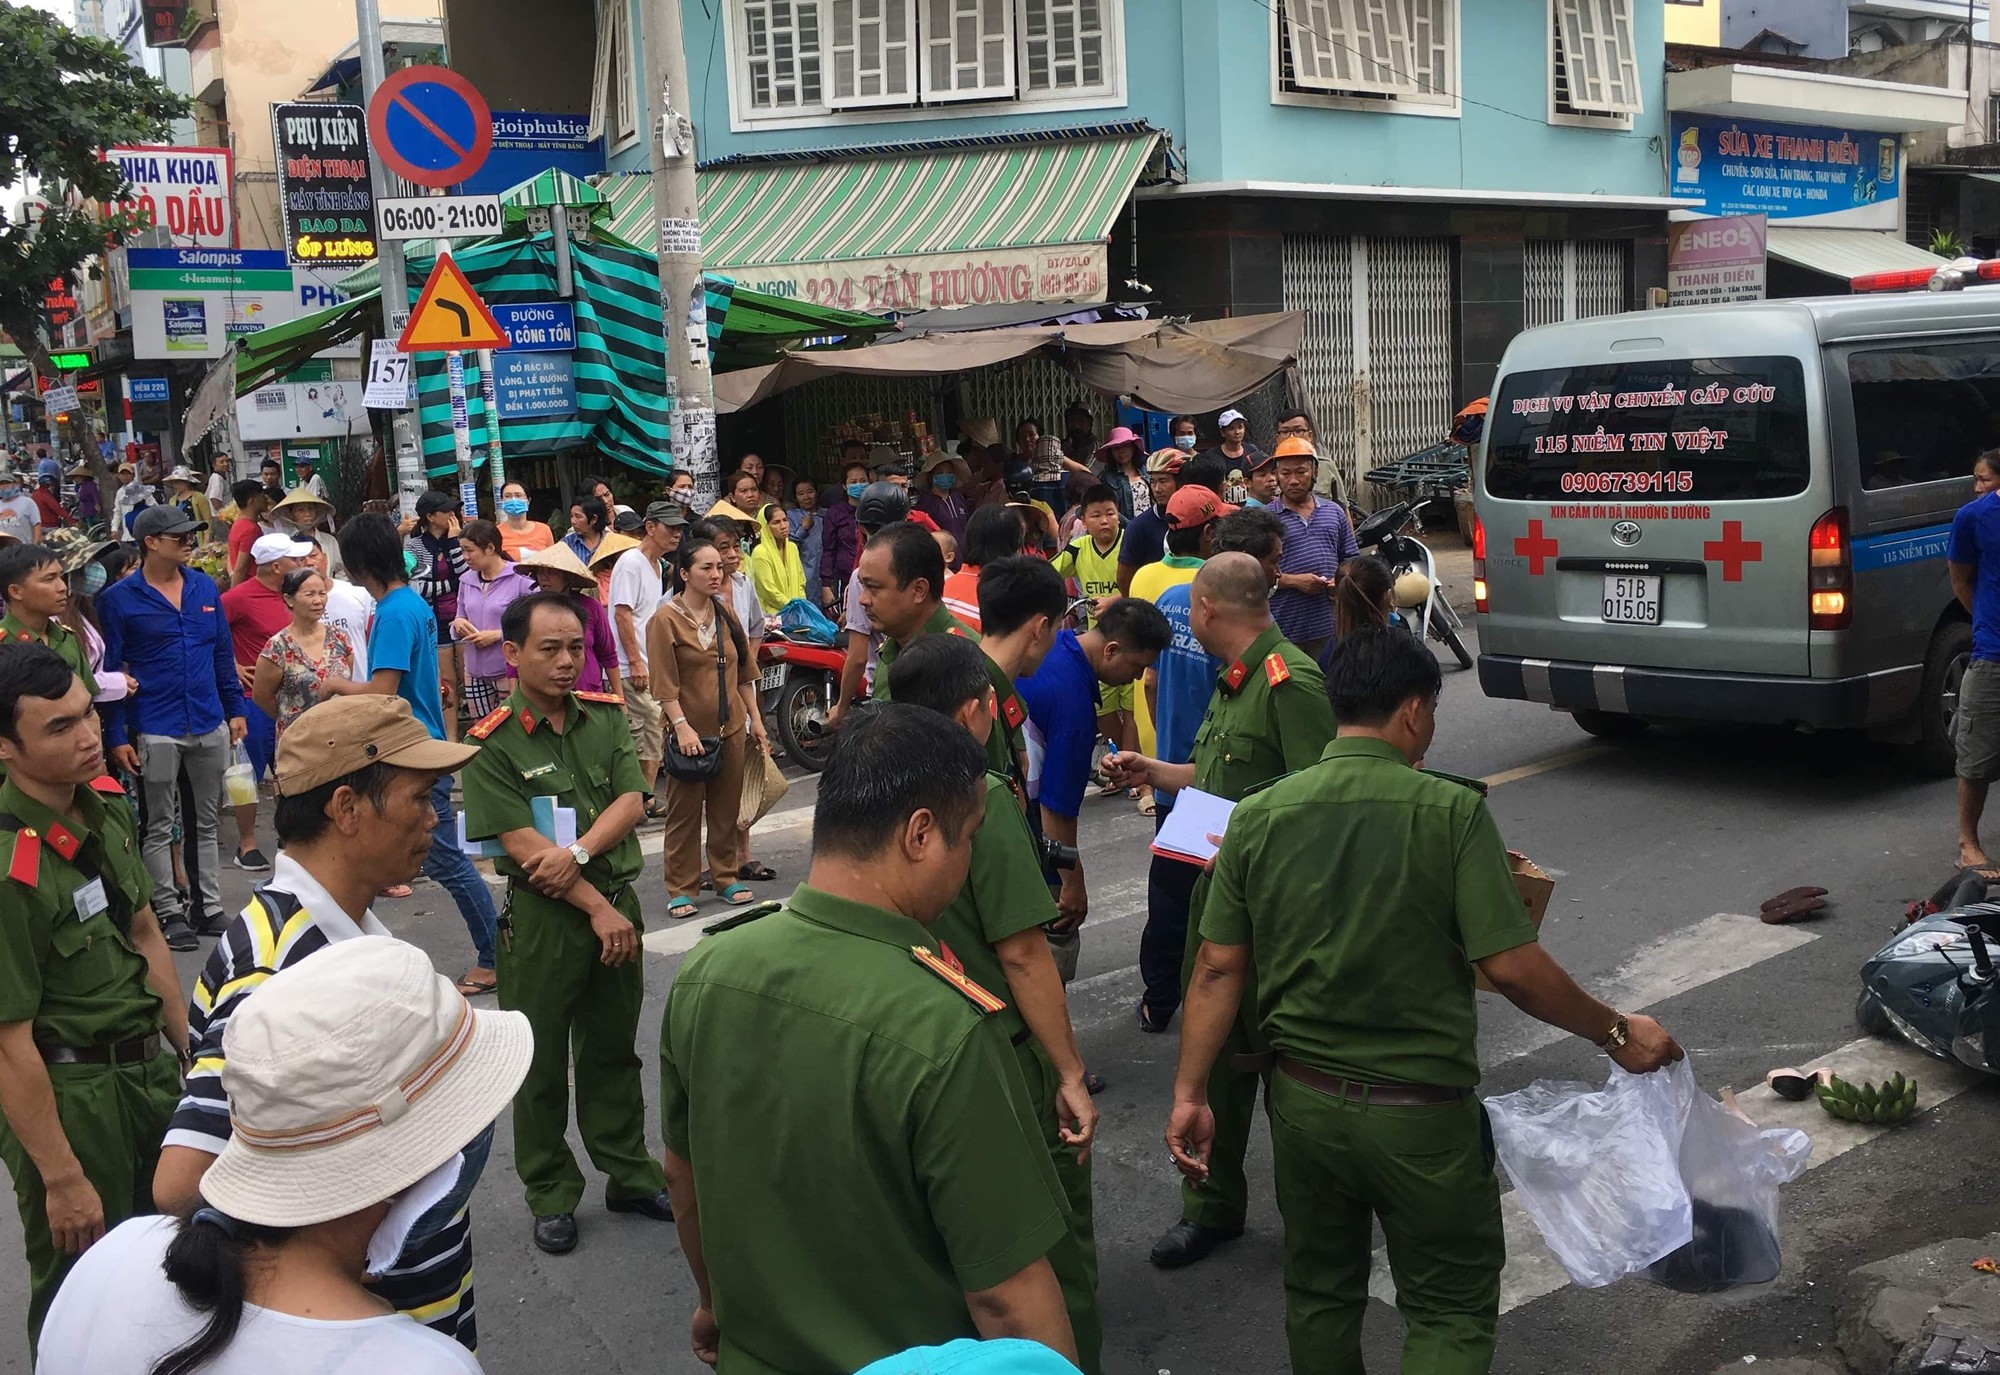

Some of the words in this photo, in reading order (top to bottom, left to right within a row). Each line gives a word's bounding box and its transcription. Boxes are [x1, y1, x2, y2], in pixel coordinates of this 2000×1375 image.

[285, 117, 318, 150] PHỤ
[320, 110, 358, 152] KIỆN
[1719, 124, 1750, 156] SỬA
[1752, 134, 1773, 158] XE
[1776, 136, 1824, 162] THANH
[1682, 150, 1698, 162] TOP
[120, 157, 161, 183] NHA
[166, 158, 218, 185] KHOA
[288, 154, 322, 182] ĐIỆN
[323, 159, 366, 182] THOẠI
[1750, 166, 1764, 178] SƠN
[1772, 186, 1781, 198] XE
[1793, 187, 1802, 199] GA
[1806, 188, 1828, 200] HONDA
[166, 186, 224, 236] DẦU
[384, 206, 434, 232] 06:00
[448, 204, 498, 228] 21:00
[299, 218, 338, 233] BAO
[340, 218, 367, 233] DA
[296, 235, 322, 257] ỐP
[324, 238, 374, 257] LƯNG
[1680, 228, 1751, 251] ENEOS
[178, 250, 242, 266] Salonpas
[756, 280, 797, 297] NGON
[806, 277, 855, 310] 224
[863, 263, 919, 308] TÂN
[929, 260, 1033, 306] HƯƠNG
[1677, 272, 1719, 287] THANH
[168, 320, 202, 330] Salonpas
[511, 308, 555, 322] ĐƯỜNG
[515, 325, 546, 344] CÔNG
[549, 322, 571, 342] TỒN
[369, 359, 408, 383] 157
[539, 372, 569, 383] ĐƯỜNG
[508, 390, 517, 400] BỊ
[519, 388, 541, 399] PHẠT
[1512, 398, 1549, 416] DỊCH
[1552, 396, 1574, 414] VỤ
[1577, 391, 1611, 412] VẬN
[1615, 383, 1687, 408] CHUYỂN
[1691, 382, 1729, 405] CẤP
[1733, 383, 1776, 403] CỨU
[1535, 435, 1567, 453] 115
[1572, 425, 1625, 453] NIỀM
[1630, 433, 1667, 451] TIN
[1673, 426, 1728, 454] VIỆT
[1561, 471, 1693, 492] 0906739115
[1200, 501, 1214, 518] MU
[1550, 506, 1566, 518] XIN
[1569, 503, 1591, 519] CẢM
[1593, 505, 1606, 519] ƠN
[1609, 504, 1622, 519] ĐÃ
[1625, 504, 1669, 520] NHƯỜNG
[1671, 504, 1710, 520] ĐƯỜNG
[1883, 551, 1897, 563] 115
[1924, 542, 1941, 555] TIN
[1086, 581, 1119, 594] ETIHA
[1616, 579, 1645, 599] 51B
[1604, 599, 1656, 620] 015.05
[1174, 621, 1193, 634] TOT
